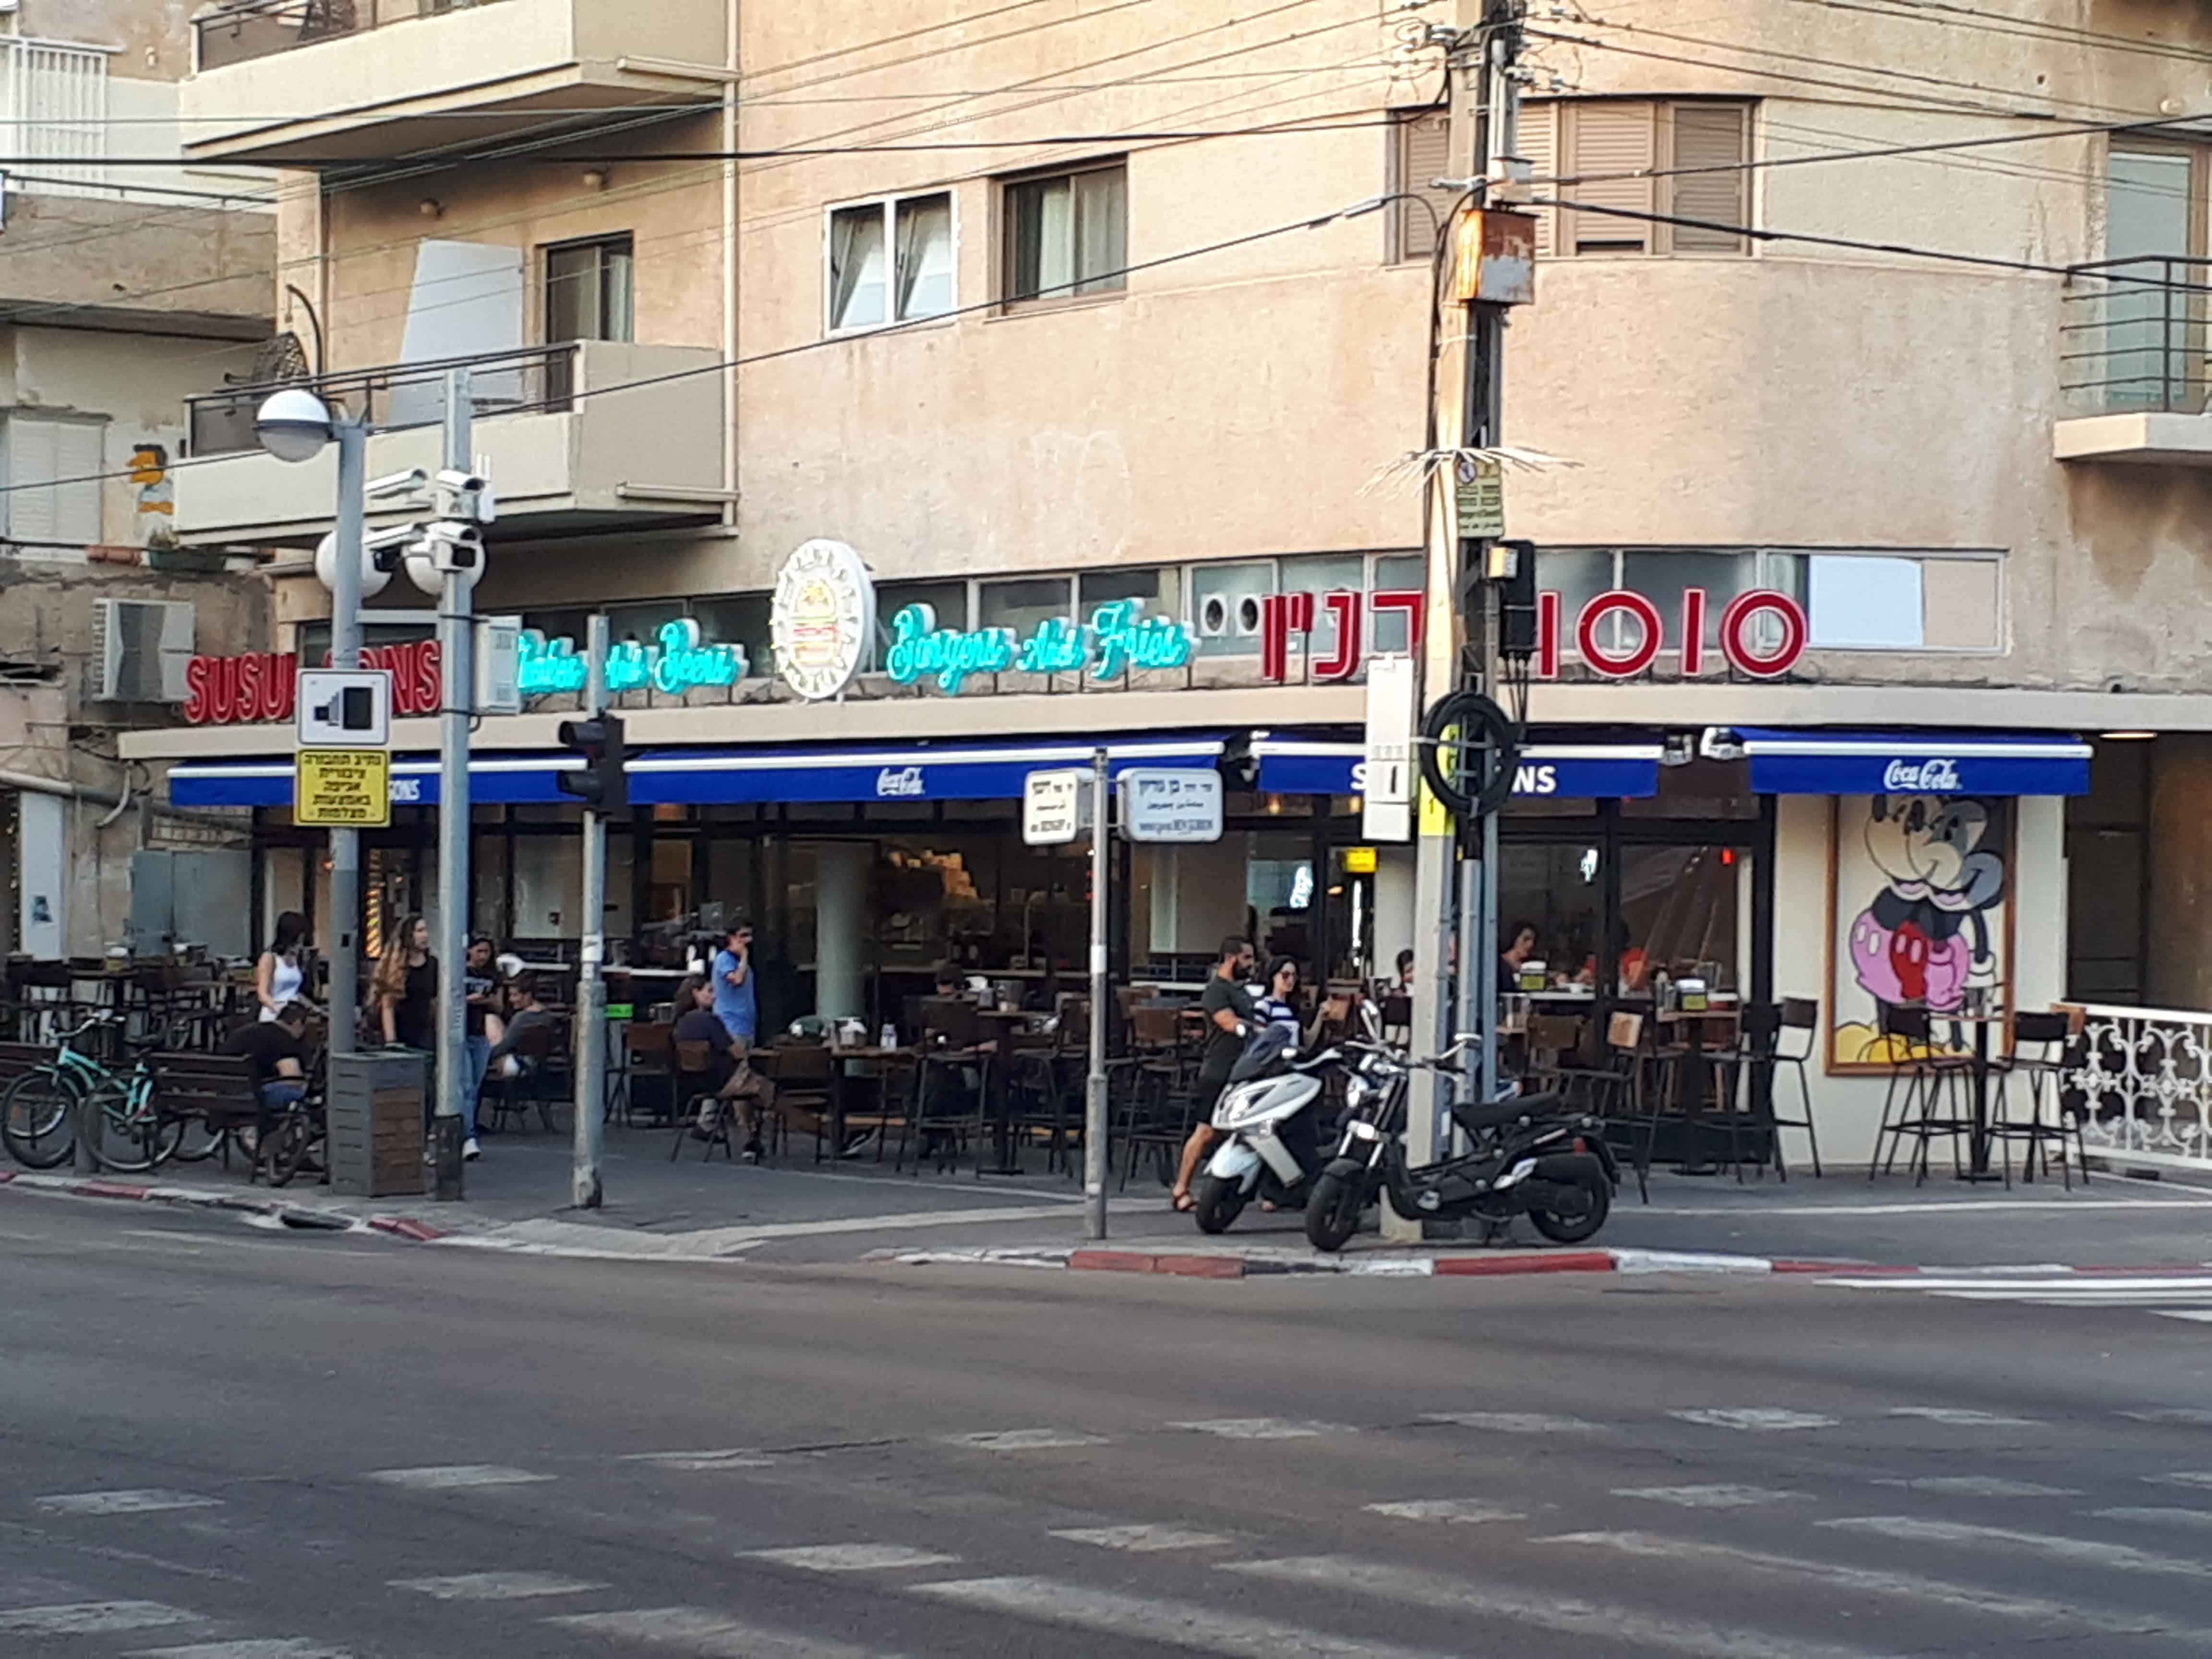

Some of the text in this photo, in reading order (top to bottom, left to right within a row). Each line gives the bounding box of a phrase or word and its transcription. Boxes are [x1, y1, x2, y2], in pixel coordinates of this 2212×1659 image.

[1090, 600, 1193, 680] Fries
[1262, 589, 1427, 682] בניו
[184, 651, 296, 723] SUSU
[389, 779, 420, 802] ONS
